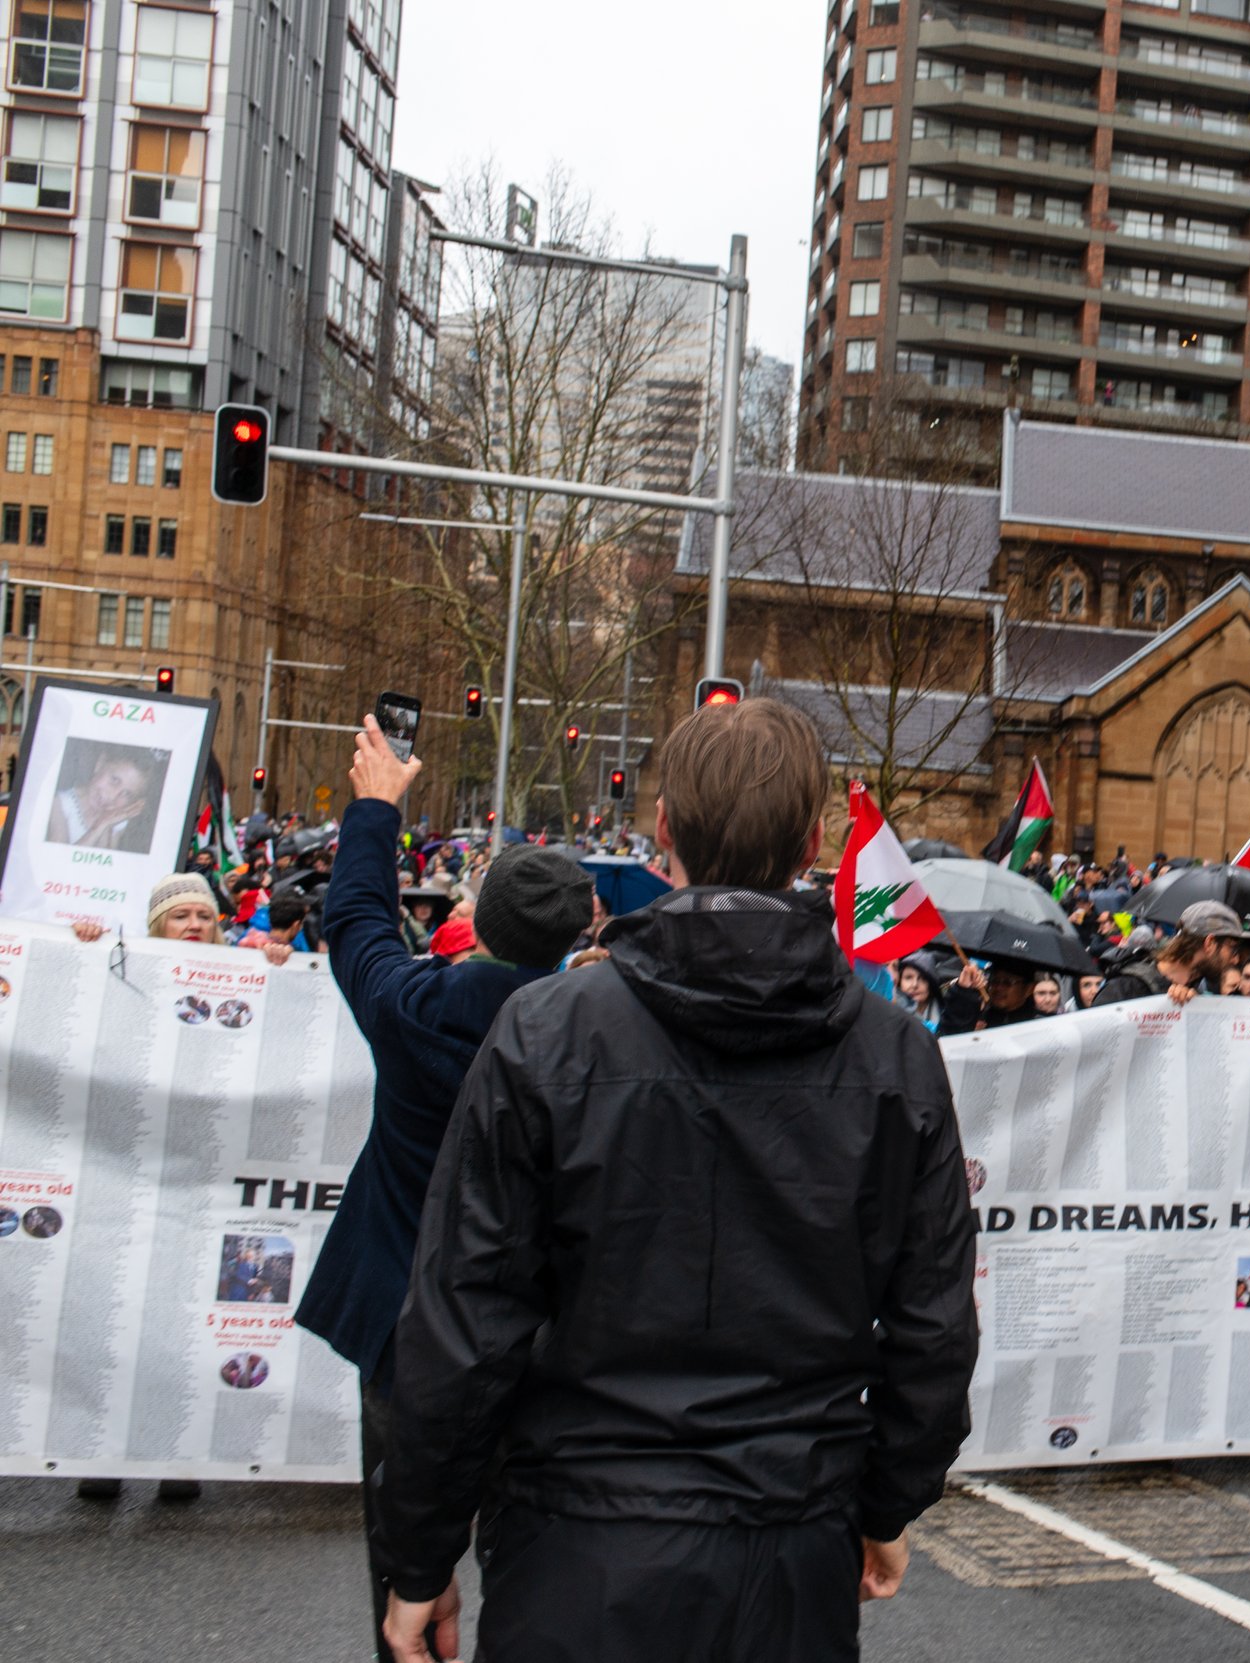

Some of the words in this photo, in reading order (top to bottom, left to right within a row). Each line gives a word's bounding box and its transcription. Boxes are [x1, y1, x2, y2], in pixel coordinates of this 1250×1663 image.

[92, 699, 156, 724] GAZA
[71, 850, 114, 867] DIMA
[42, 880, 127, 903] 2011-2021
[188, 969, 233, 981] years
[239, 974, 266, 985] old
[1142, 1012, 1164, 1024] years
[1166, 1010, 1181, 1021] old
[47, 1182, 73, 1195] old
[233, 1176, 344, 1211] THE
[1028, 1203, 1218, 1232] DREAMS,
[206, 1313, 215, 1326] 5
[221, 1317, 264, 1330] years
[269, 1316, 295, 1328] old
